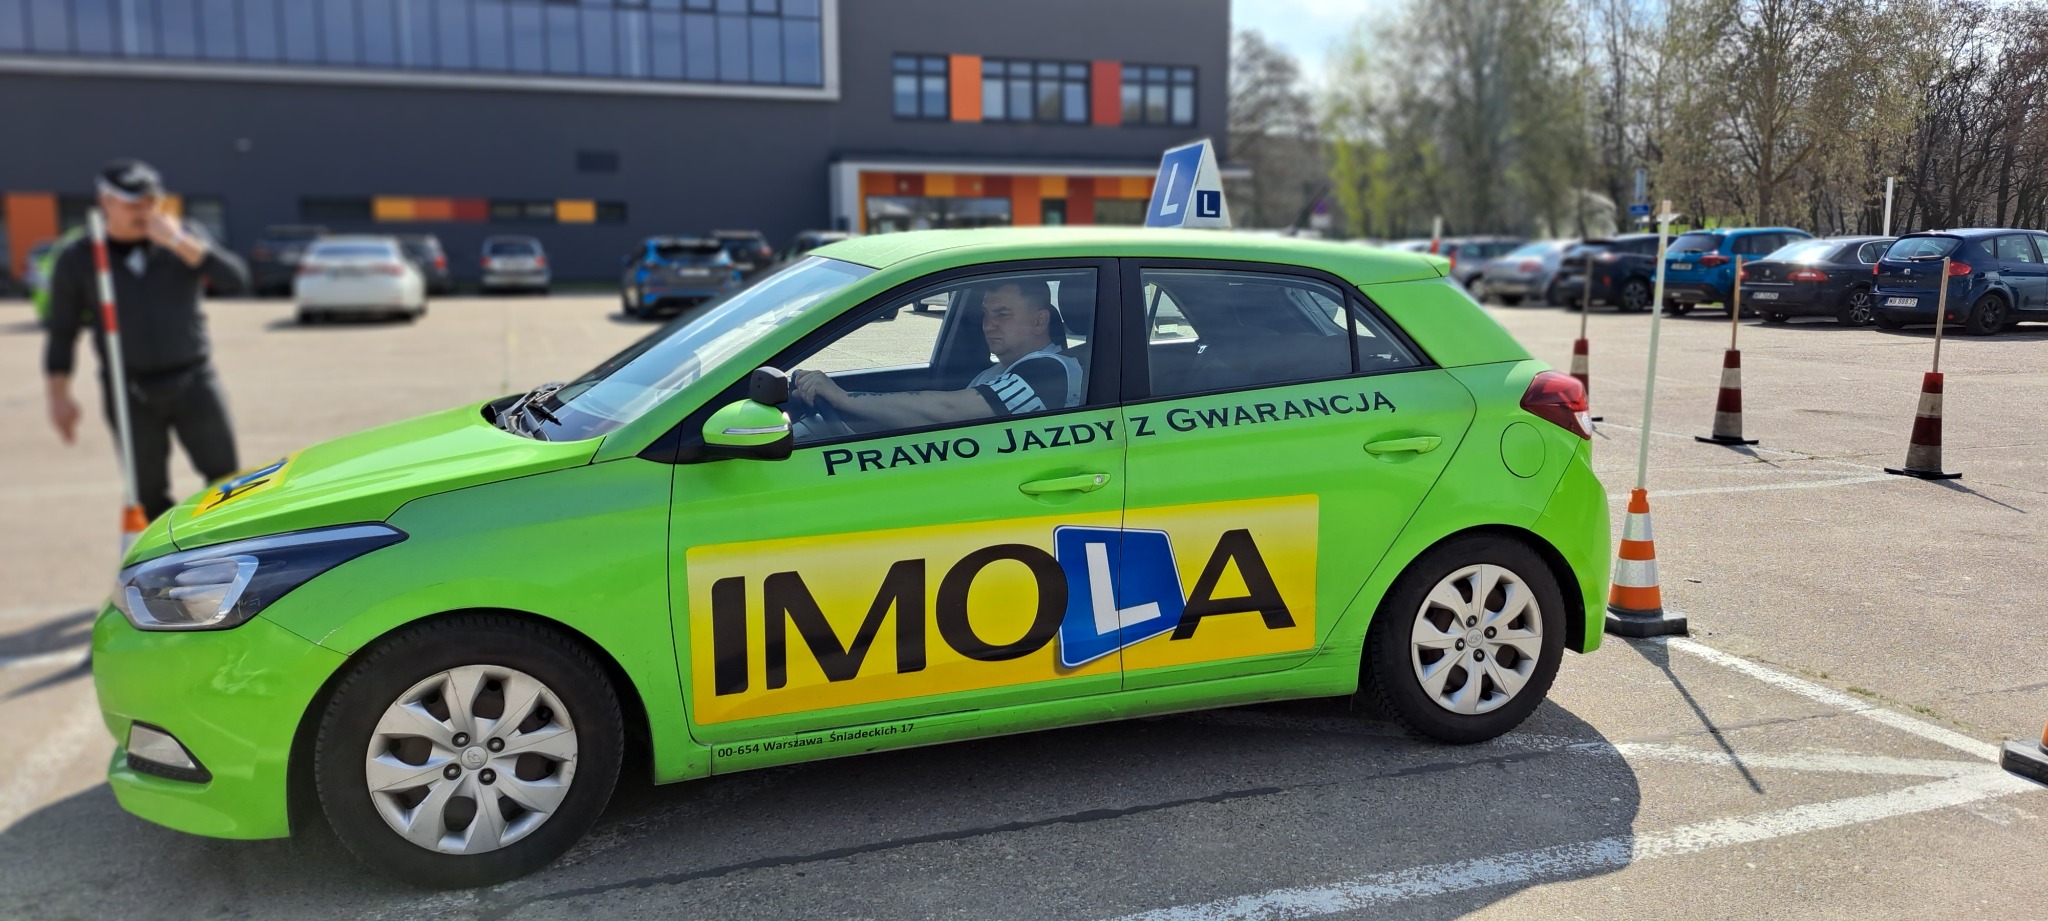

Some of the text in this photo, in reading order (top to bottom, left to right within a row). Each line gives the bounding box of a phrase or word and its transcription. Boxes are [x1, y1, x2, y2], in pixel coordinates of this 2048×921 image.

[1160, 163, 1179, 216] L
[1204, 194, 1216, 215] L
[711, 527, 1297, 697] IMOLA
[718, 723, 914, 758] 00-654 Warszawa Śniadeckich 17
